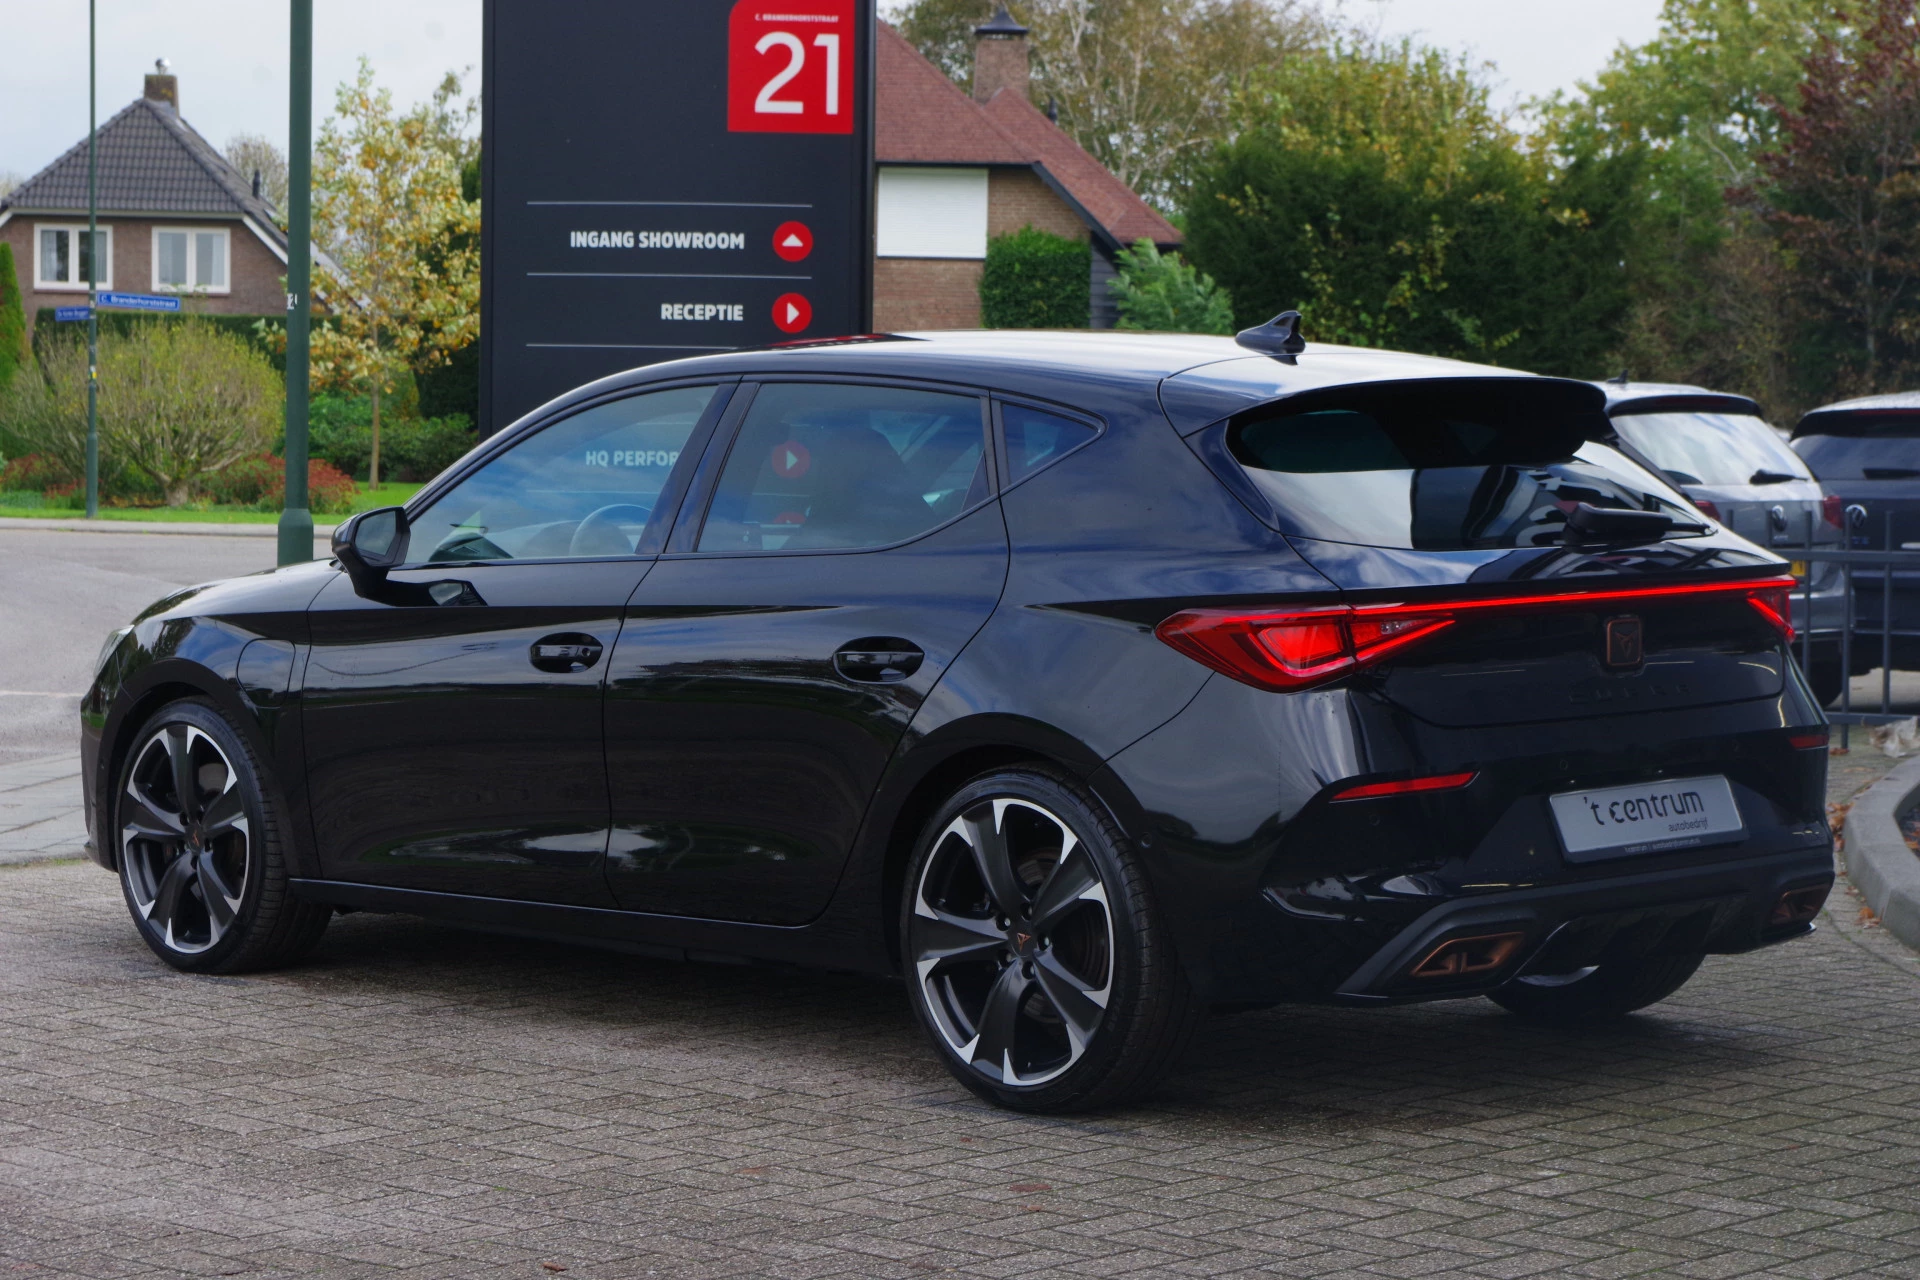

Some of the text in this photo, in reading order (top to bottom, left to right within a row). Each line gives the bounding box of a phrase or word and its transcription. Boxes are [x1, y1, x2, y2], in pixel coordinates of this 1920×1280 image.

[755, 31, 839, 115] 21
[570, 231, 745, 249] INGANG SHOWROOM
[661, 304, 743, 320] RECEPTIE
[586, 451, 609, 467] HQ
[1609, 791, 1704, 823] centrum
[1668, 817, 1708, 832] autobedrijf
